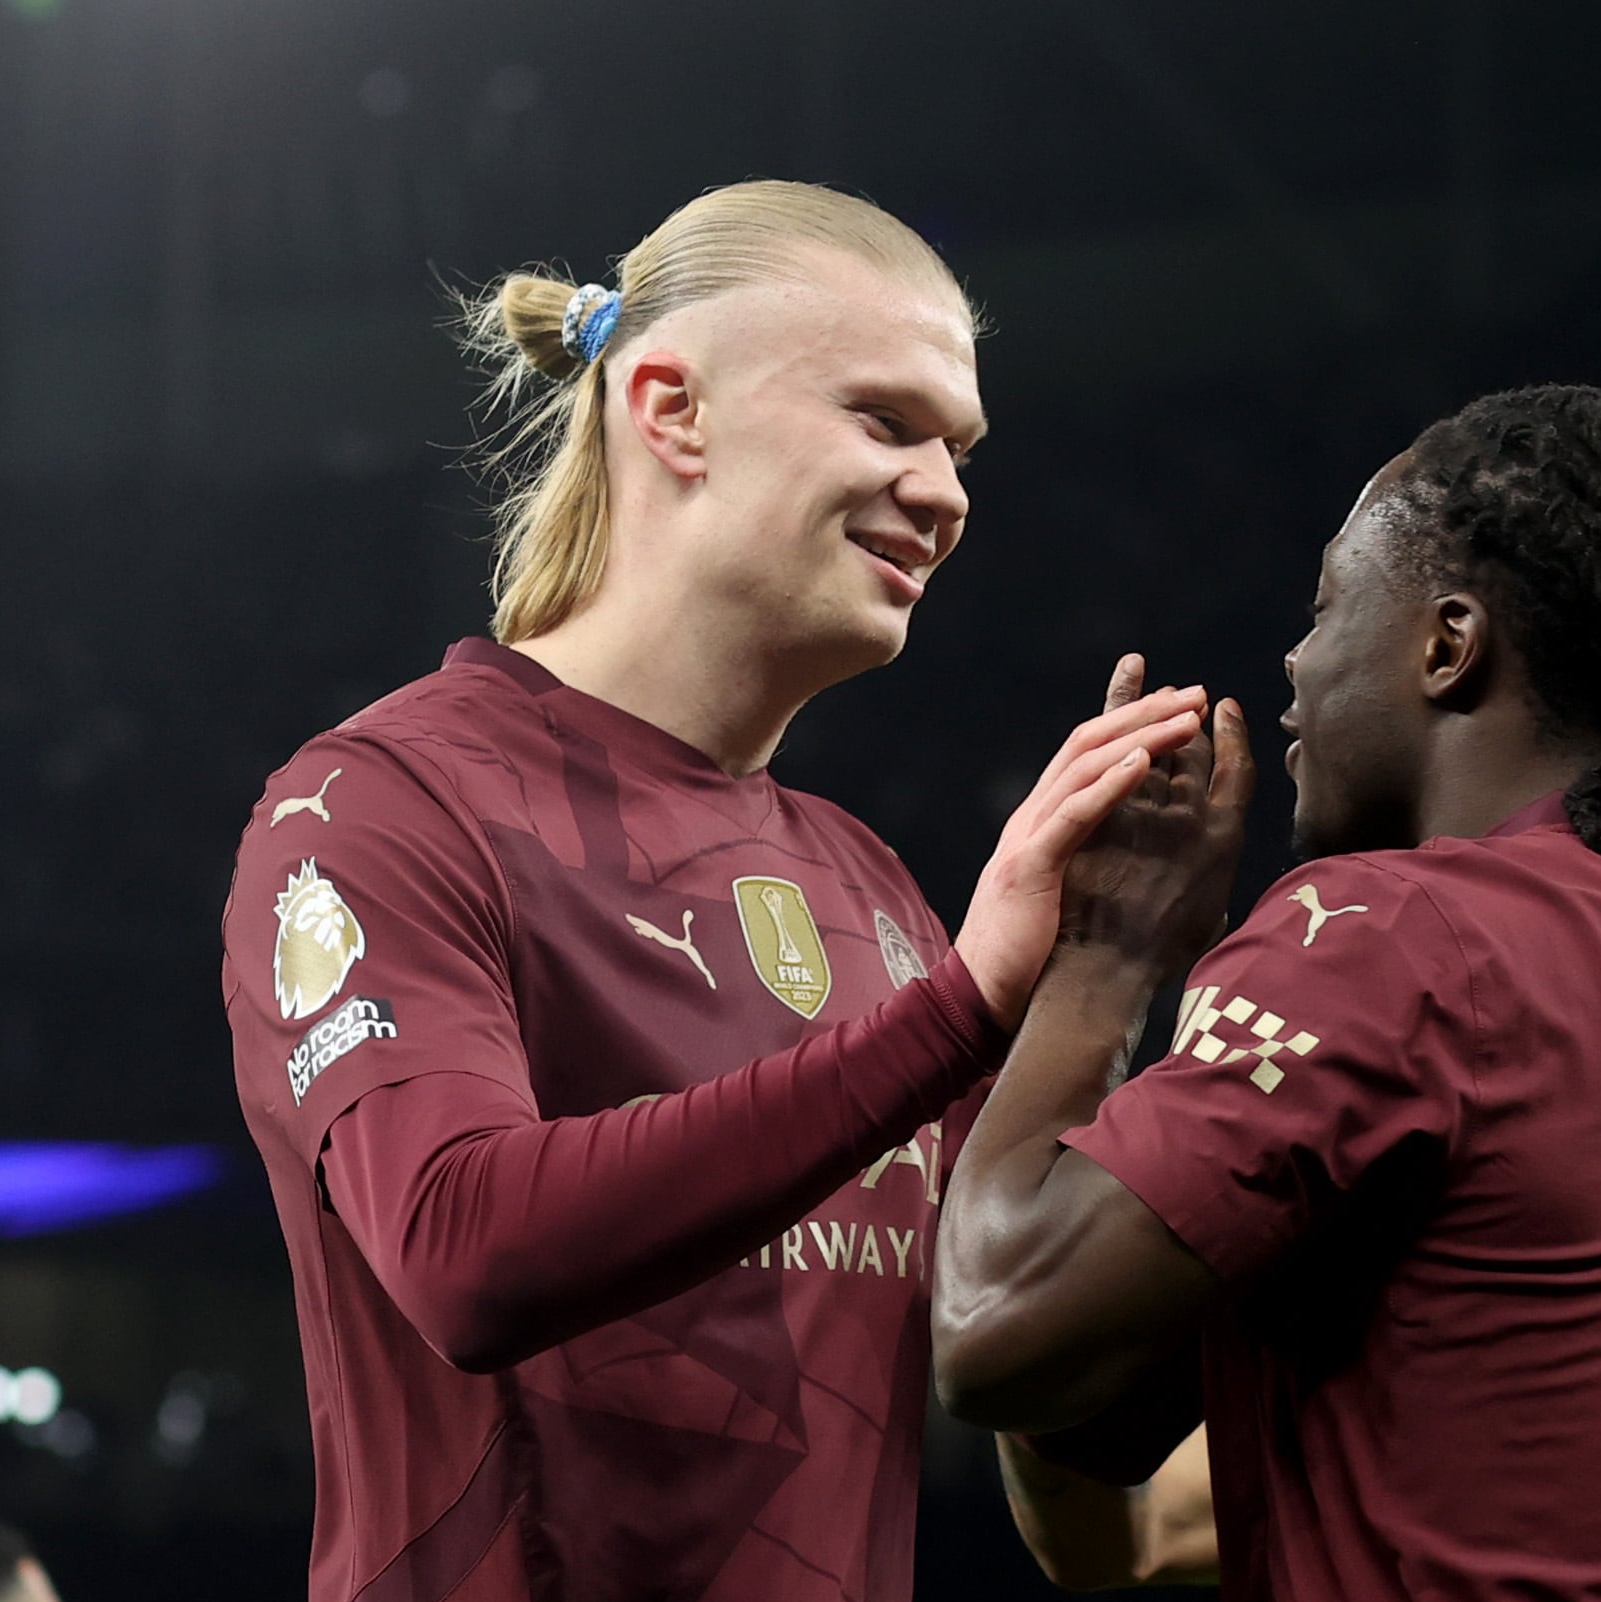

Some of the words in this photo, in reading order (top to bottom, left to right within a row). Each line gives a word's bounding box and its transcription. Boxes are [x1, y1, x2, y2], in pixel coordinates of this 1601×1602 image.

[777, 965, 815, 985] FIFA
[286, 1043, 309, 1083] No
[309, 999, 380, 1055] room
[311, 1019, 398, 1078] racism
[738, 1221, 925, 1282] IRWAY
